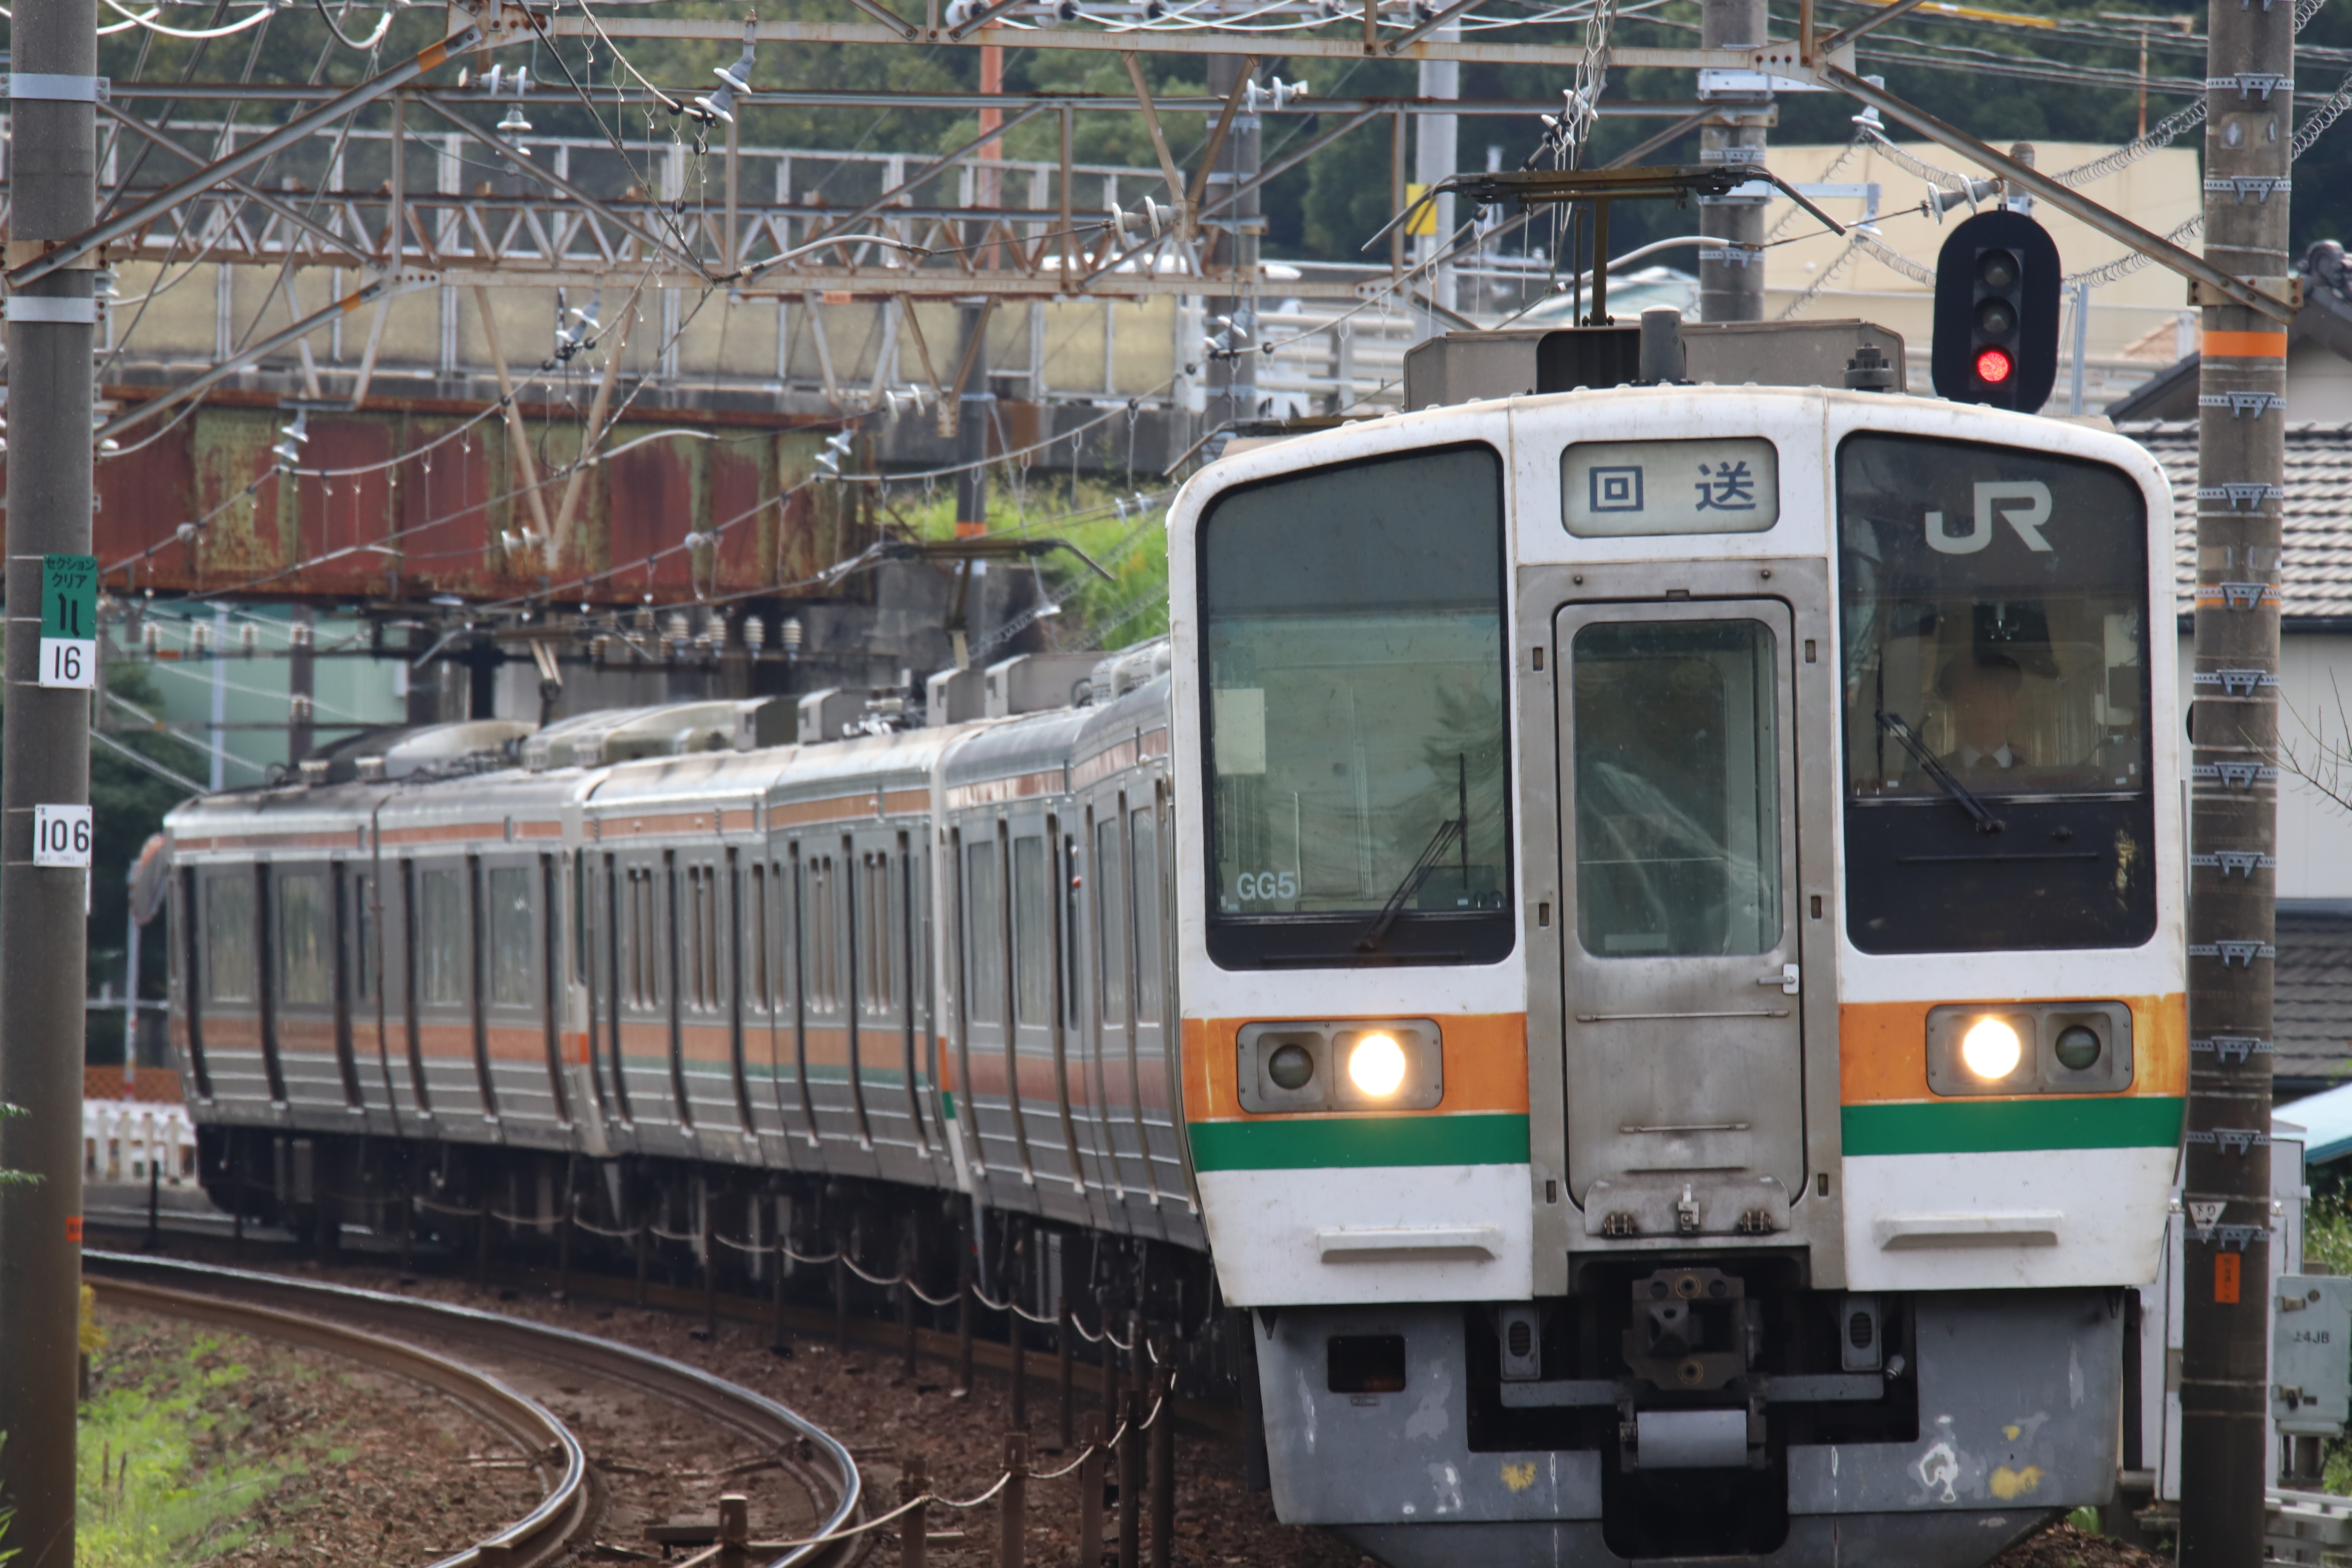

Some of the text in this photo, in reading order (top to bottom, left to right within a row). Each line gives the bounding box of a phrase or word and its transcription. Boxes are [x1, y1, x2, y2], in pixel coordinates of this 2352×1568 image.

[1589, 461, 1757, 512] 回送
[1925, 481, 2054, 554] JR
[46, 557, 95, 571] セクション
[52, 572, 87, 589] クリア
[55, 645, 81, 680] 16
[41, 819, 89, 853] 106
[1237, 871, 1296, 900] GG5
